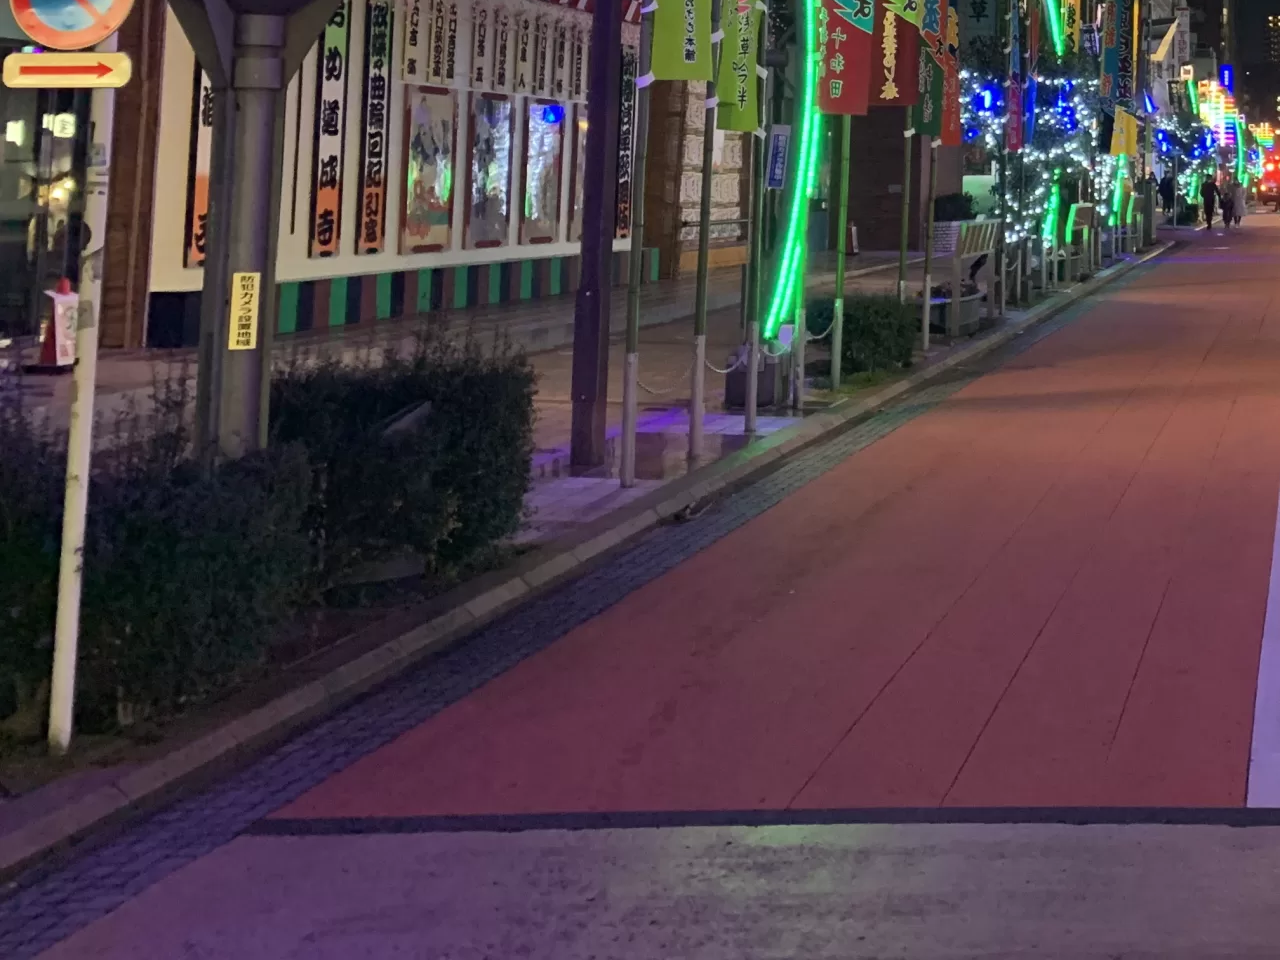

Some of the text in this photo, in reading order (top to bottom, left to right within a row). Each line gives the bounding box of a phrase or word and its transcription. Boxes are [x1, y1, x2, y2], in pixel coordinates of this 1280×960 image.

[236, 275, 256, 347] 防犯カメラ設置地域
